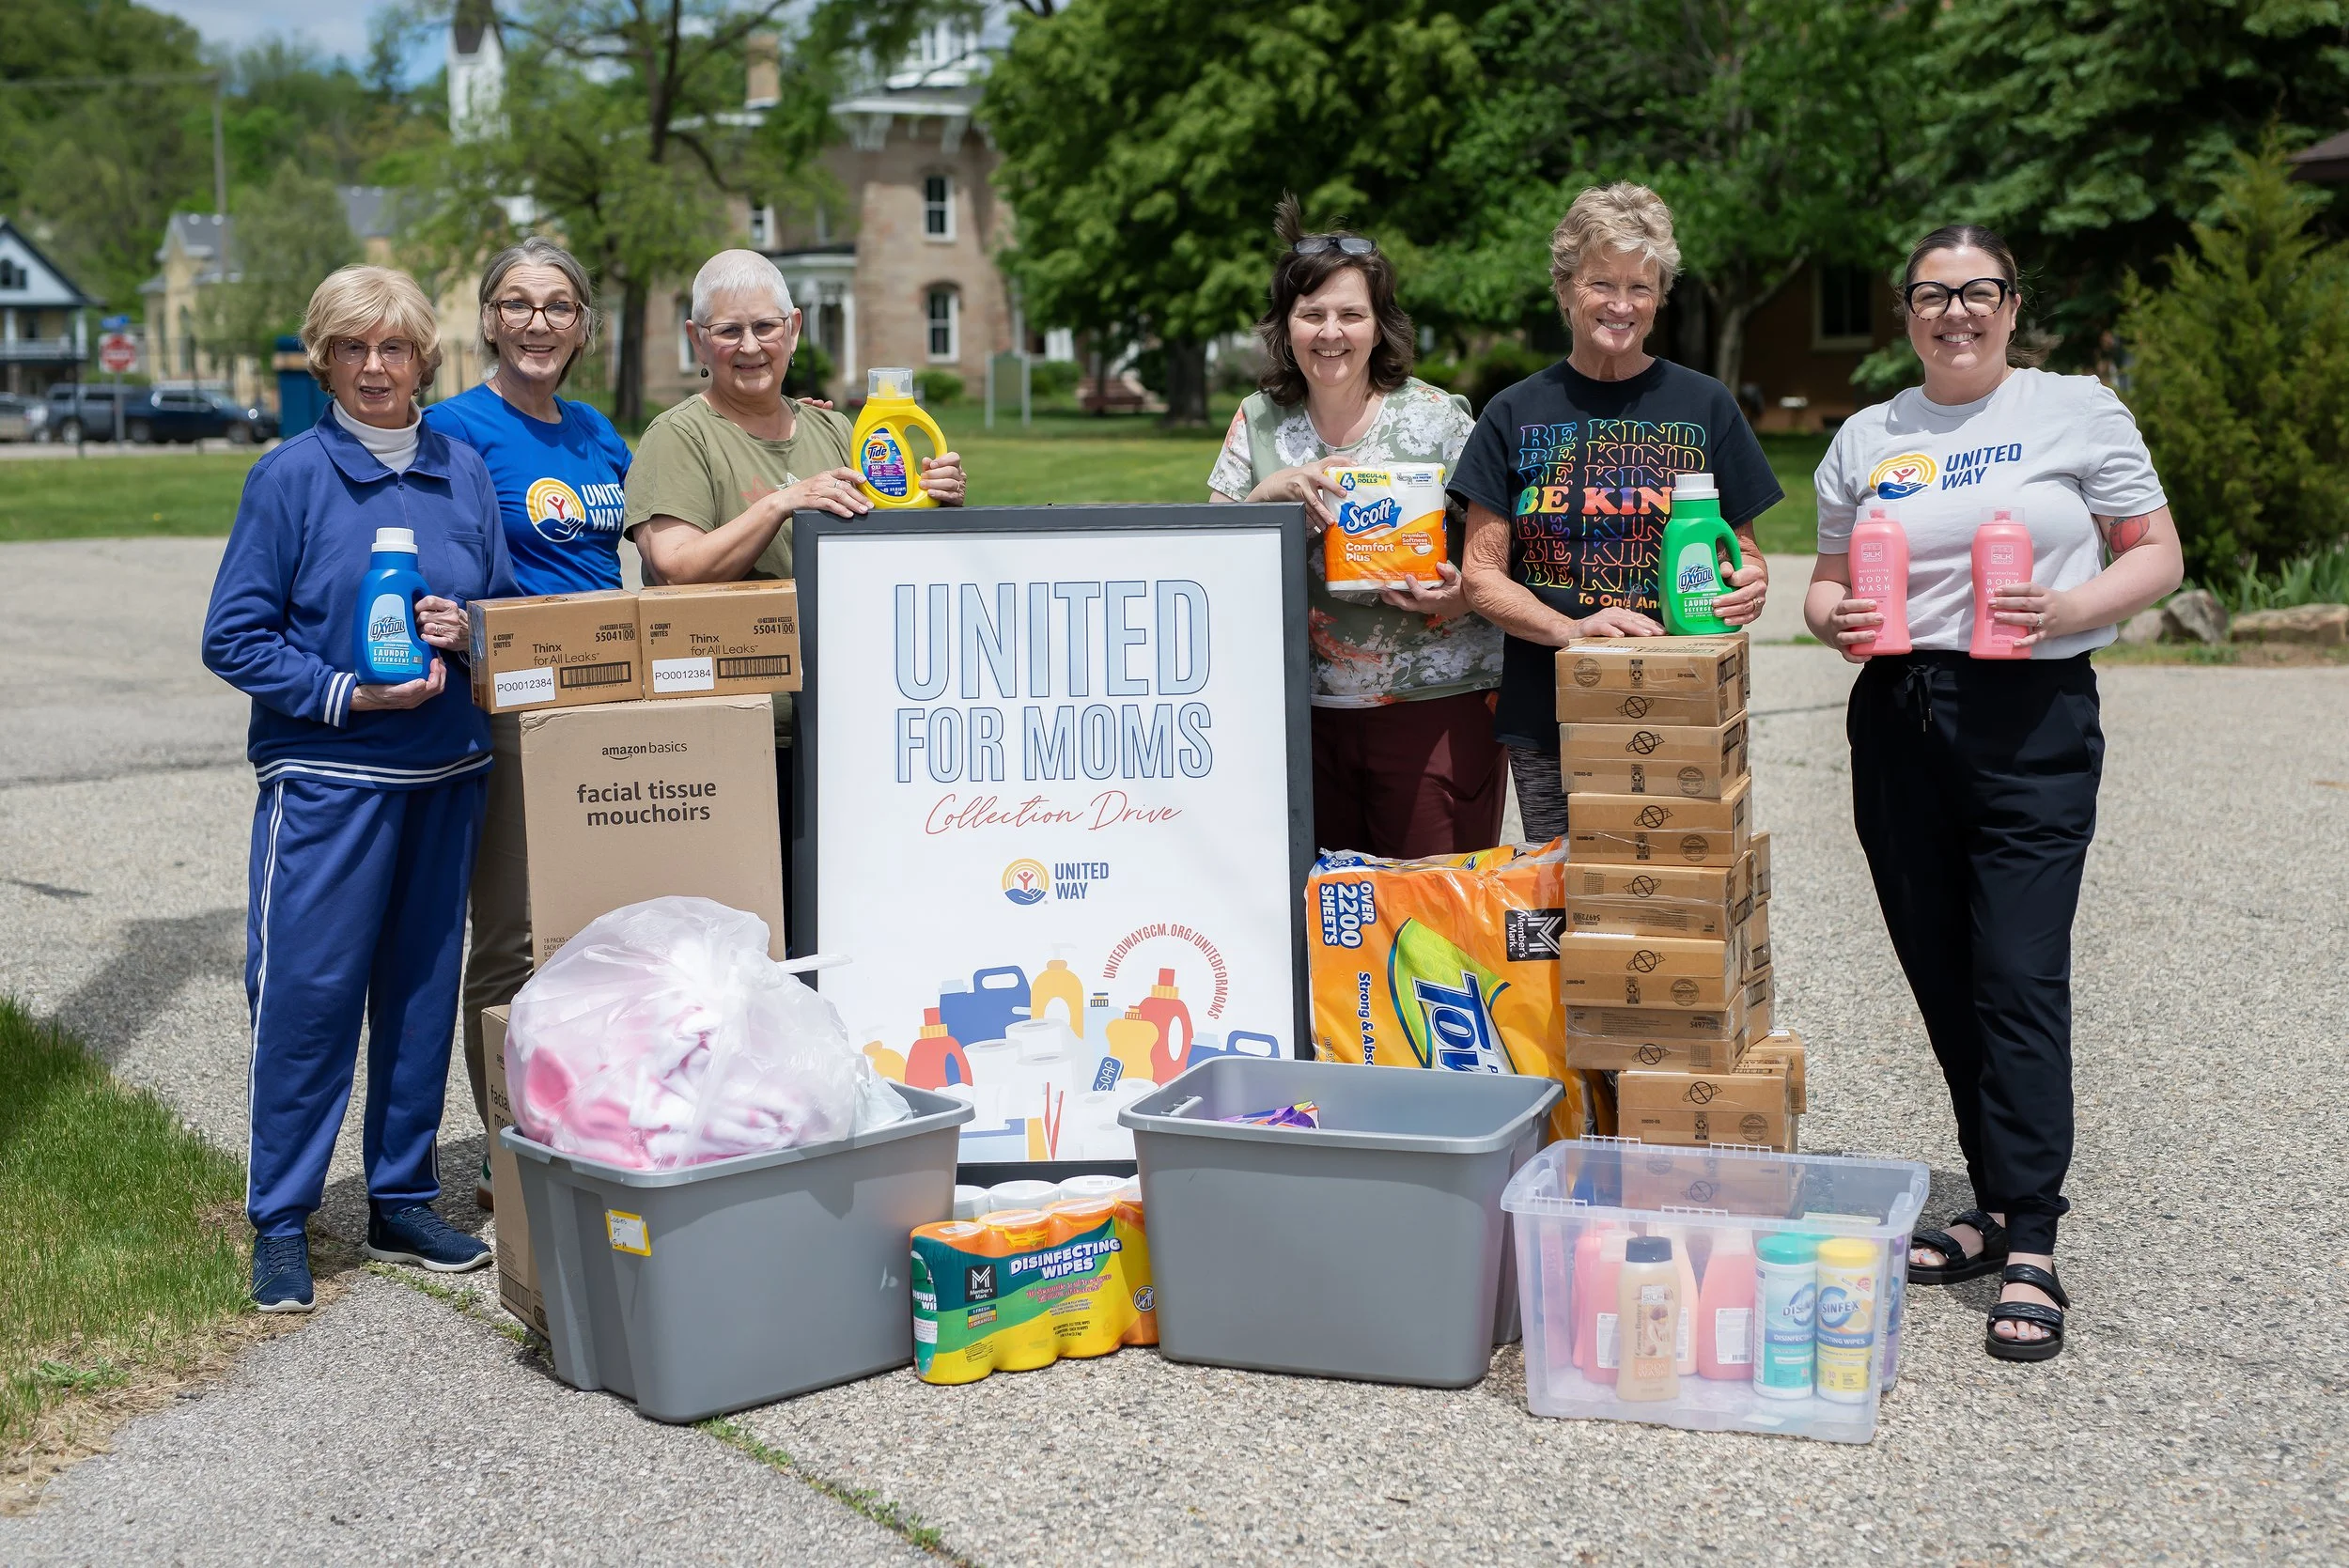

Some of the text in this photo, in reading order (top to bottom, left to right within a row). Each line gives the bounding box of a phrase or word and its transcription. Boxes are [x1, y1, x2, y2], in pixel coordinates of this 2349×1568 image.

[1519, 418, 1706, 447] BE KIND
[867, 444, 888, 460] Tide
[1586, 441, 1705, 471] KIND
[1945, 442, 2023, 473] UNITED
[1341, 474, 1355, 490] 4
[1357, 473, 1387, 481] REGULAR
[1583, 464, 1700, 487] KIN
[1941, 466, 1988, 491] WAY
[1516, 486, 1677, 517] BE KIN
[589, 507, 624, 532] WAY
[1345, 498, 1393, 532] Scott
[1345, 542, 1395, 552] Comfort
[1345, 552, 1372, 563] Plus
[1678, 566, 1715, 594] OXYDOL
[1859, 575, 1890, 583] BODY
[1986, 578, 2019, 586] BODY
[1579, 592, 1595, 605] To
[1636, 596, 1661, 609] An
[369, 615, 406, 642] OXYDOL
[690, 634, 720, 644] Thinx
[894, 579, 1211, 701] UNITED
[373, 648, 410, 658] LAUNDRY
[532, 643, 562, 654] Thinx
[534, 656, 549, 666] for
[549, 654, 563, 664] All
[691, 646, 706, 656] for
[707, 645, 721, 655] All
[497, 677, 552, 692] PO0012384
[655, 669, 711, 681] PO0012384
[894, 703, 1214, 784] FOR MOMS
[576, 779, 717, 804] facial tissue
[586, 801, 711, 827] mouchoirs
[926, 790, 1183, 835] Collection Drive
[1054, 862, 1110, 880] UNITED
[1054, 882, 1090, 900] WAY
[1360, 882, 1375, 923] OVER
[1321, 885, 1338, 944] SHEETS
[1337, 884, 1361, 947] 2200
[1508, 924, 1517, 948] Mark
[1517, 913, 1528, 958] Member's
[1103, 923, 1228, 1020] UNITEDWAYGCM.ORG/UNITEDFORMOMS
[1358, 971, 1371, 1018] Strong
[1361, 1020, 1374, 1031] &
[1097, 1061, 1116, 1092] SOAP
[1010, 1237, 1122, 1275] DISINFECTING
[1041, 1257, 1095, 1280] WIPES
[969, 1287, 993, 1296] Member's
